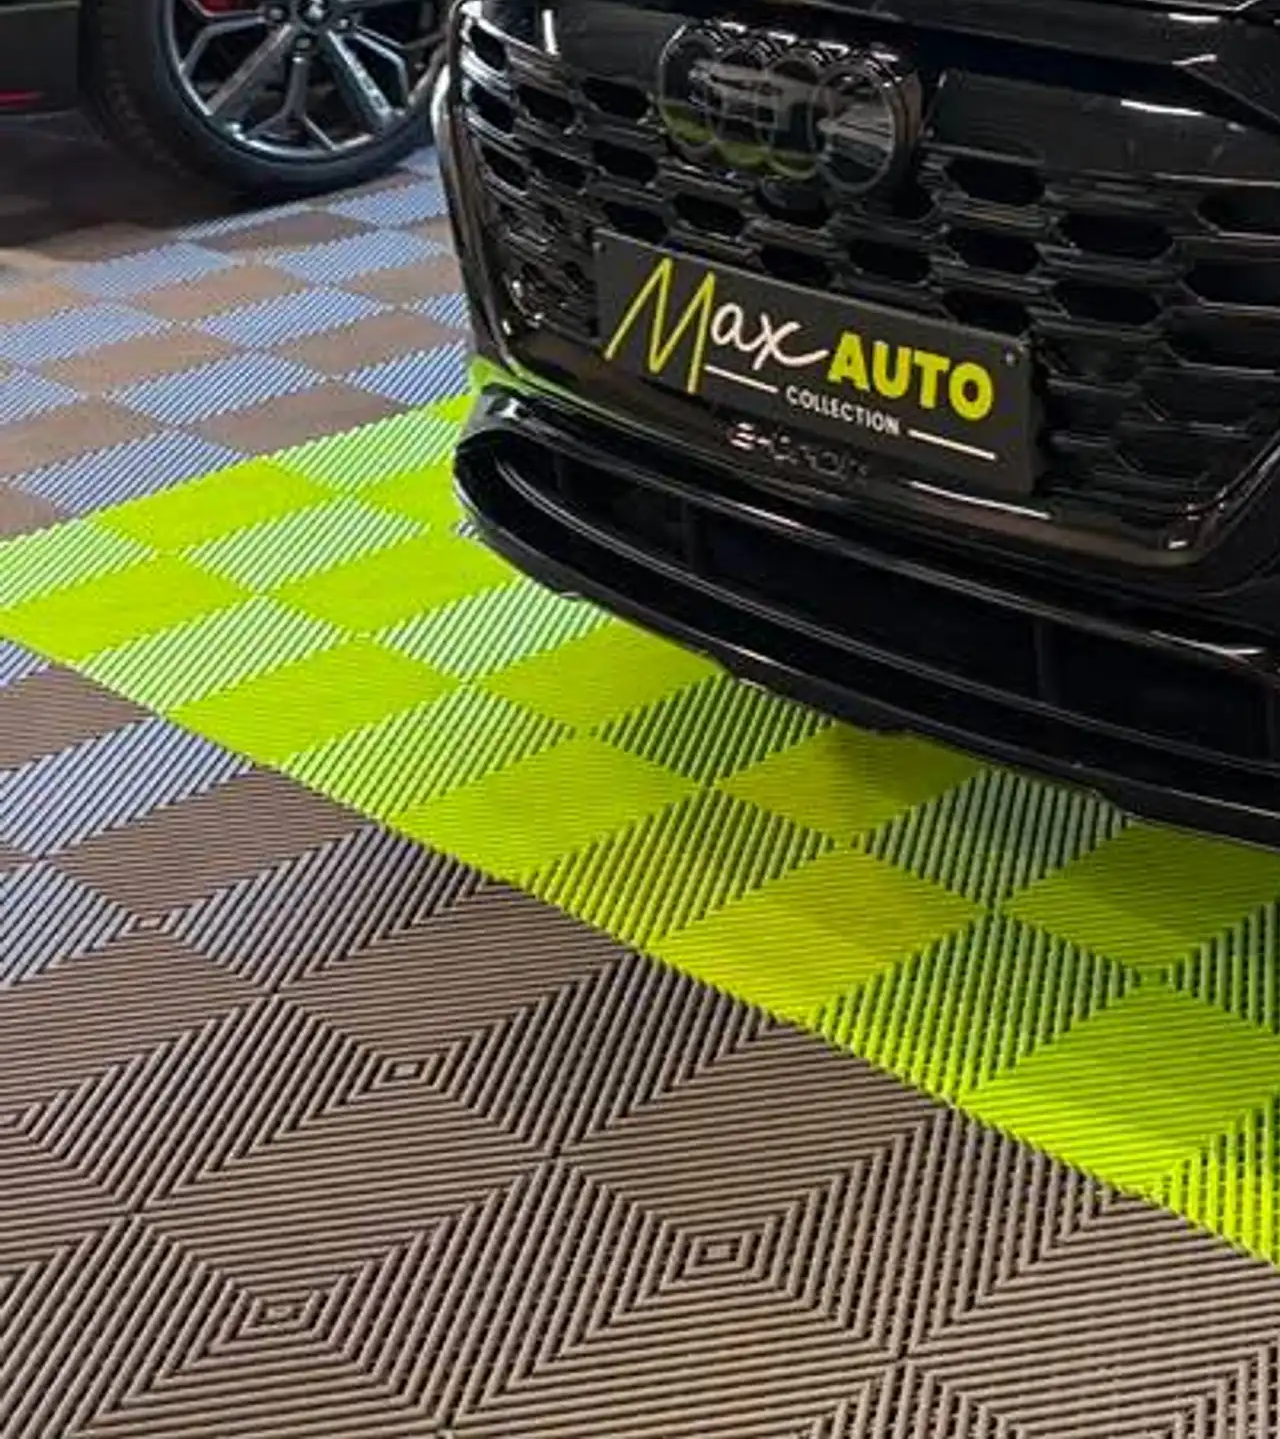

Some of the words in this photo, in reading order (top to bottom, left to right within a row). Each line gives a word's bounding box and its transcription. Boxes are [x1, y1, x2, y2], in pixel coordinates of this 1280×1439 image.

[604, 258, 829, 394] Max
[827, 332, 994, 421] AUTO
[785, 384, 900, 436] COLLECTION
